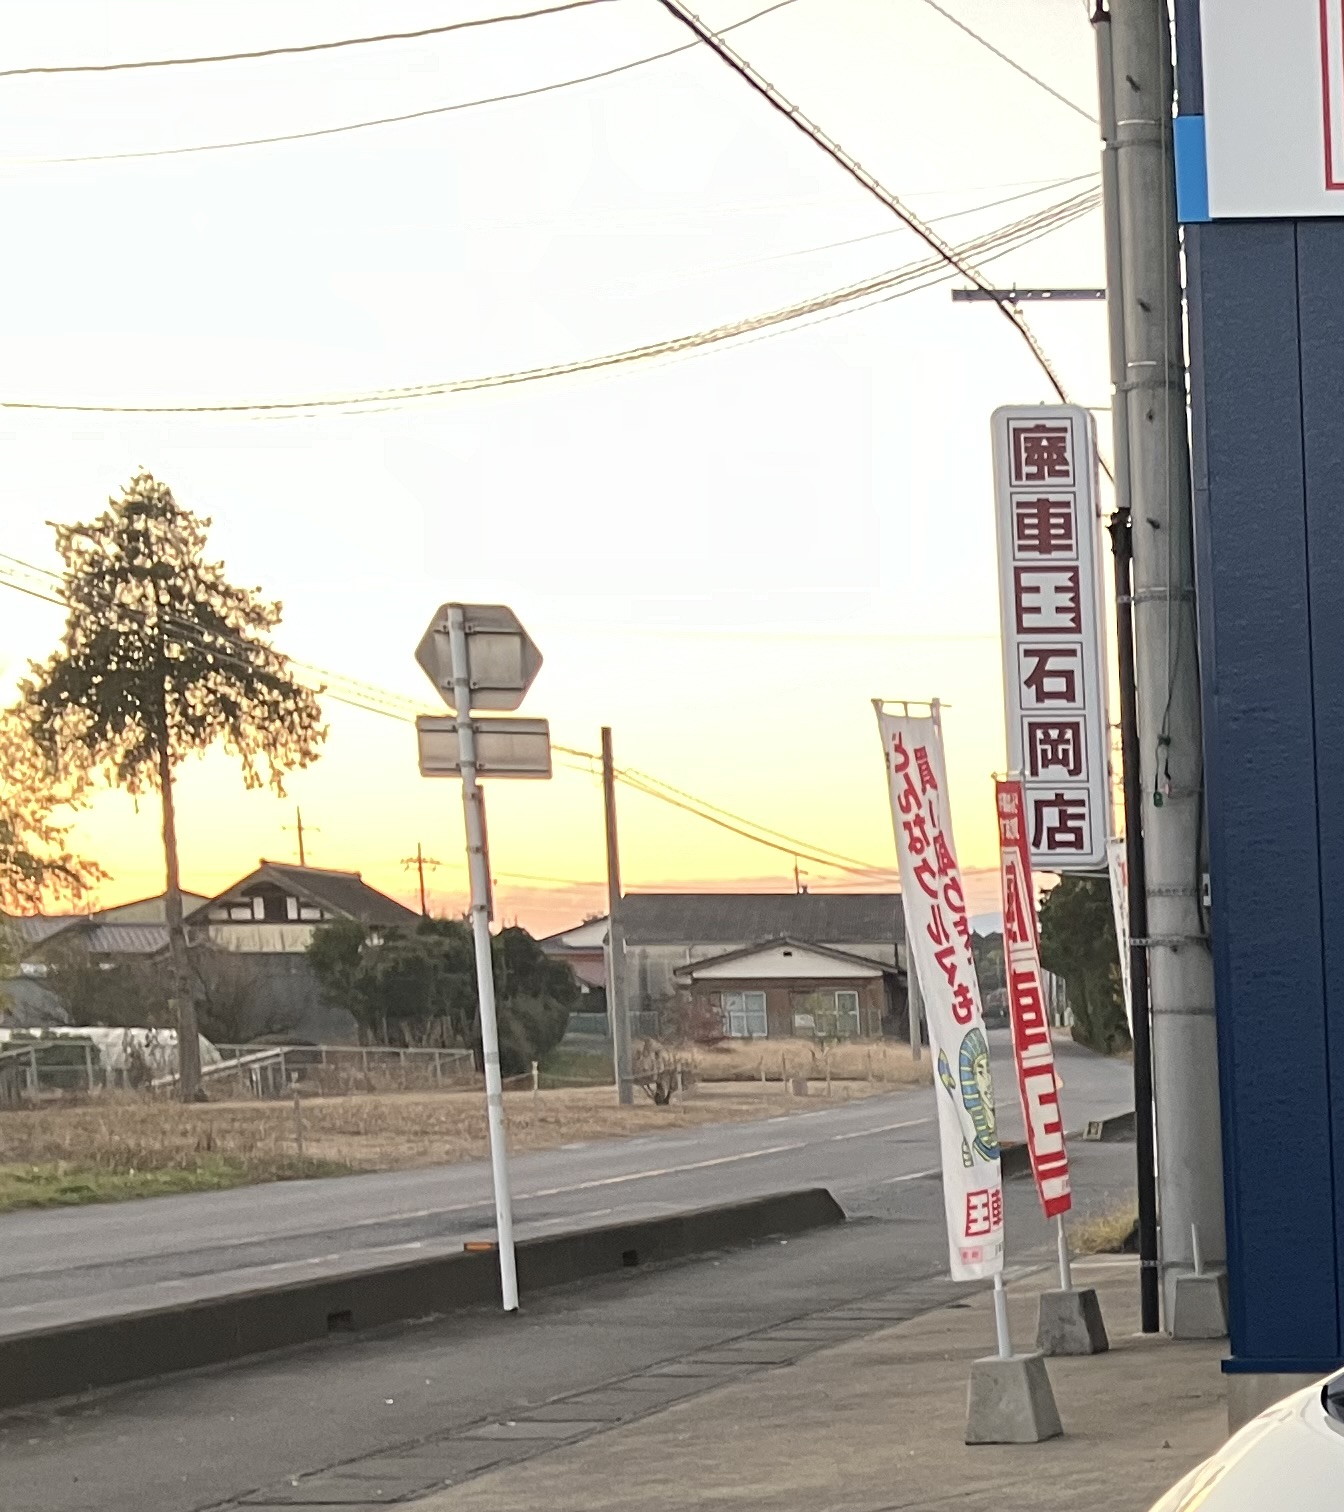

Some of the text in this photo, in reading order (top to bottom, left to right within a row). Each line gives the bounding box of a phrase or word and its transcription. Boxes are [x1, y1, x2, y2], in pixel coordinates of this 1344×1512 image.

[1013, 424, 1087, 852] 廃車王石岡店
